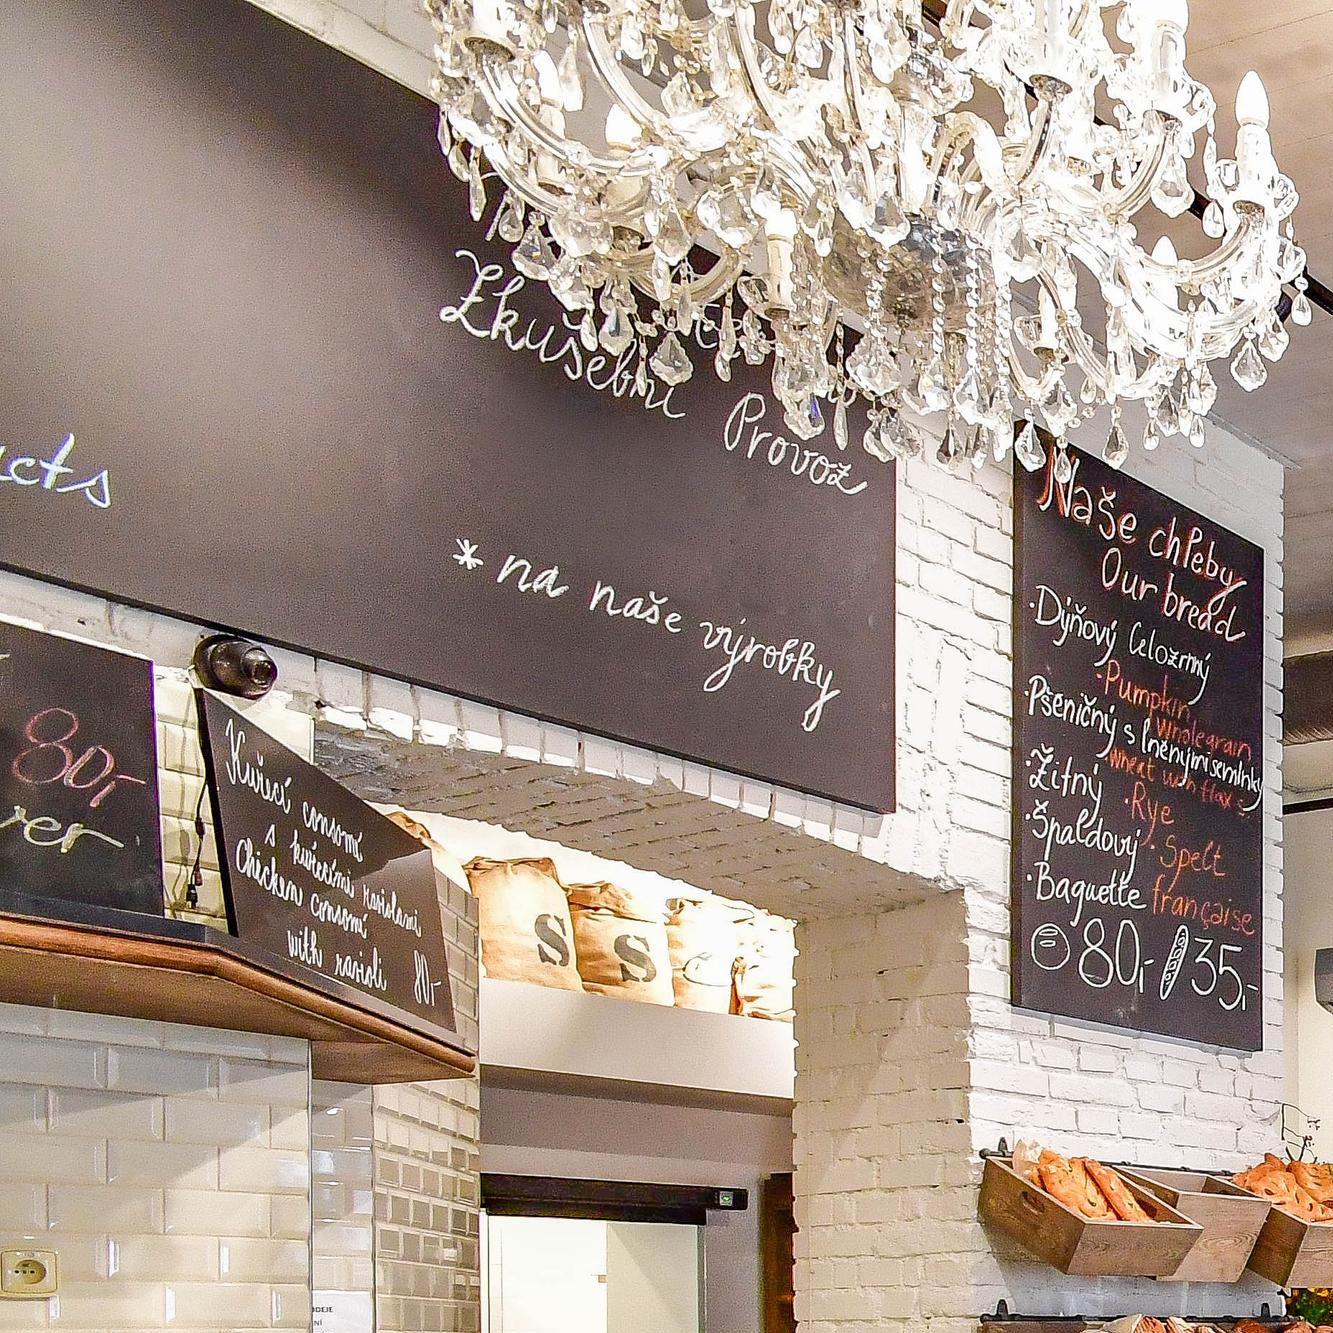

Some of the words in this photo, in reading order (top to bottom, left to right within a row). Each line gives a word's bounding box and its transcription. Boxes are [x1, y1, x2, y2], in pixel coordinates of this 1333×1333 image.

[0, 431, 113, 509] cts
[724, 391, 868, 496] Provoz
[1036, 446, 1138, 544] Naše
[1149, 516, 1248, 616] chleby
[1034, 584, 1118, 668] Dýňový
[1102, 547, 1158, 602] Our
[1162, 572, 1246, 642] bread
[497, 553, 570, 598] na
[589, 580, 683, 634] naše
[699, 617, 841, 732] výrobky
[1027, 674, 1119, 759] Pšeničný
[1123, 723, 1136, 745] s
[1104, 659, 1191, 721] Pumpkin
[1028, 743, 1103, 829] Žitný
[1130, 781, 1175, 848] Rye
[235, 837, 304, 908] Chicken
[264, 823, 277, 848] s
[1031, 798, 1142, 886] Špaldový
[1160, 833, 1226, 892] Spelt
[1034, 861, 1147, 928] Baguette
[1152, 873, 1256, 936] française
[286, 925, 323, 969] with
[335, 946, 387, 992] ravioli
[534, 913, 570, 967] S
[614, 934, 657, 983] S
